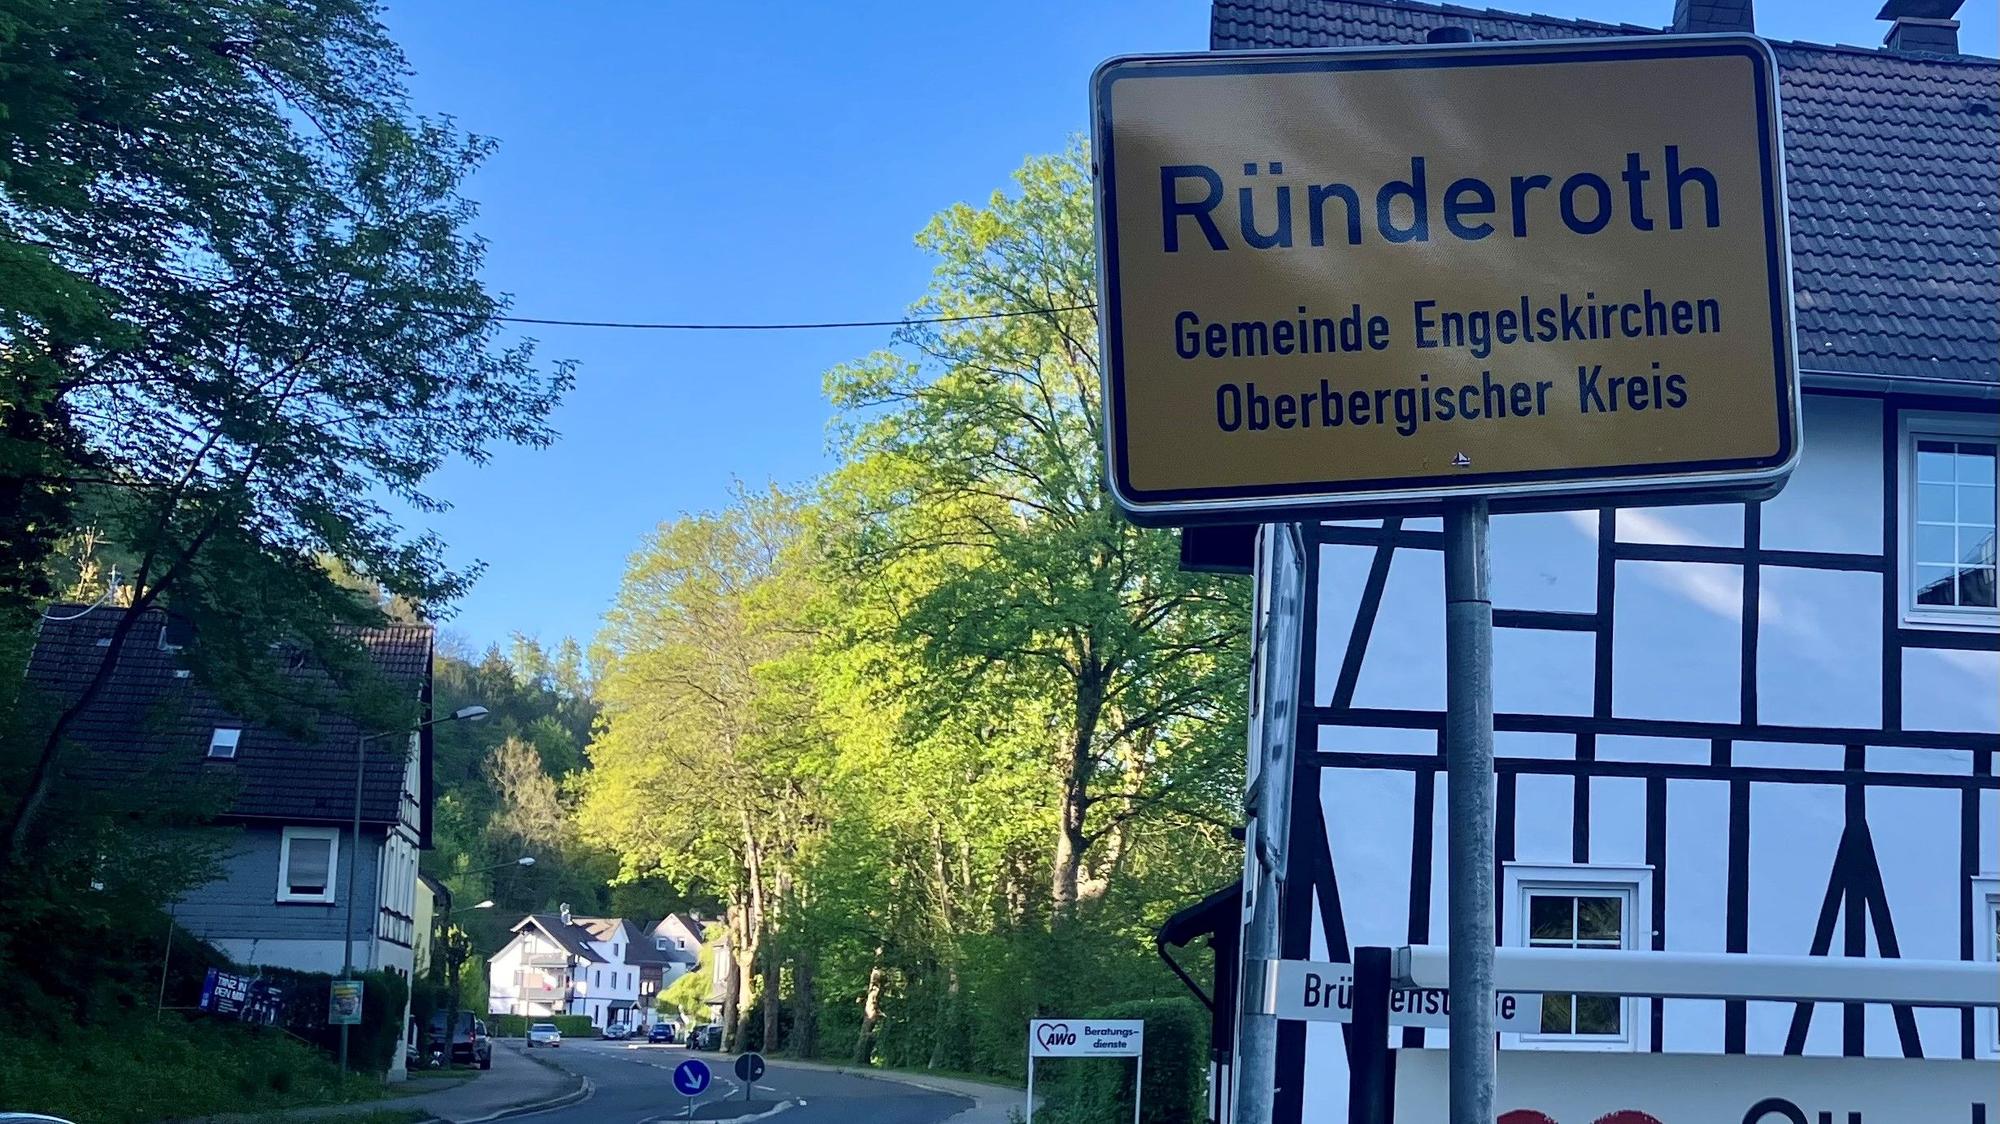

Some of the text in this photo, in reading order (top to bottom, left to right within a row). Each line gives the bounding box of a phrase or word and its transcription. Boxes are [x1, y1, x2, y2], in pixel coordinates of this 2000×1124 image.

[1160, 145, 1720, 253] Ründeroth
[1174, 289, 1721, 359] Gemeinde Engelskirchen
[1216, 361, 1688, 436] Oberbergischer Kreis
[1046, 1026, 1140, 1046] AWO Beratungs-
[1093, 1038, 1127, 1049] dienste
